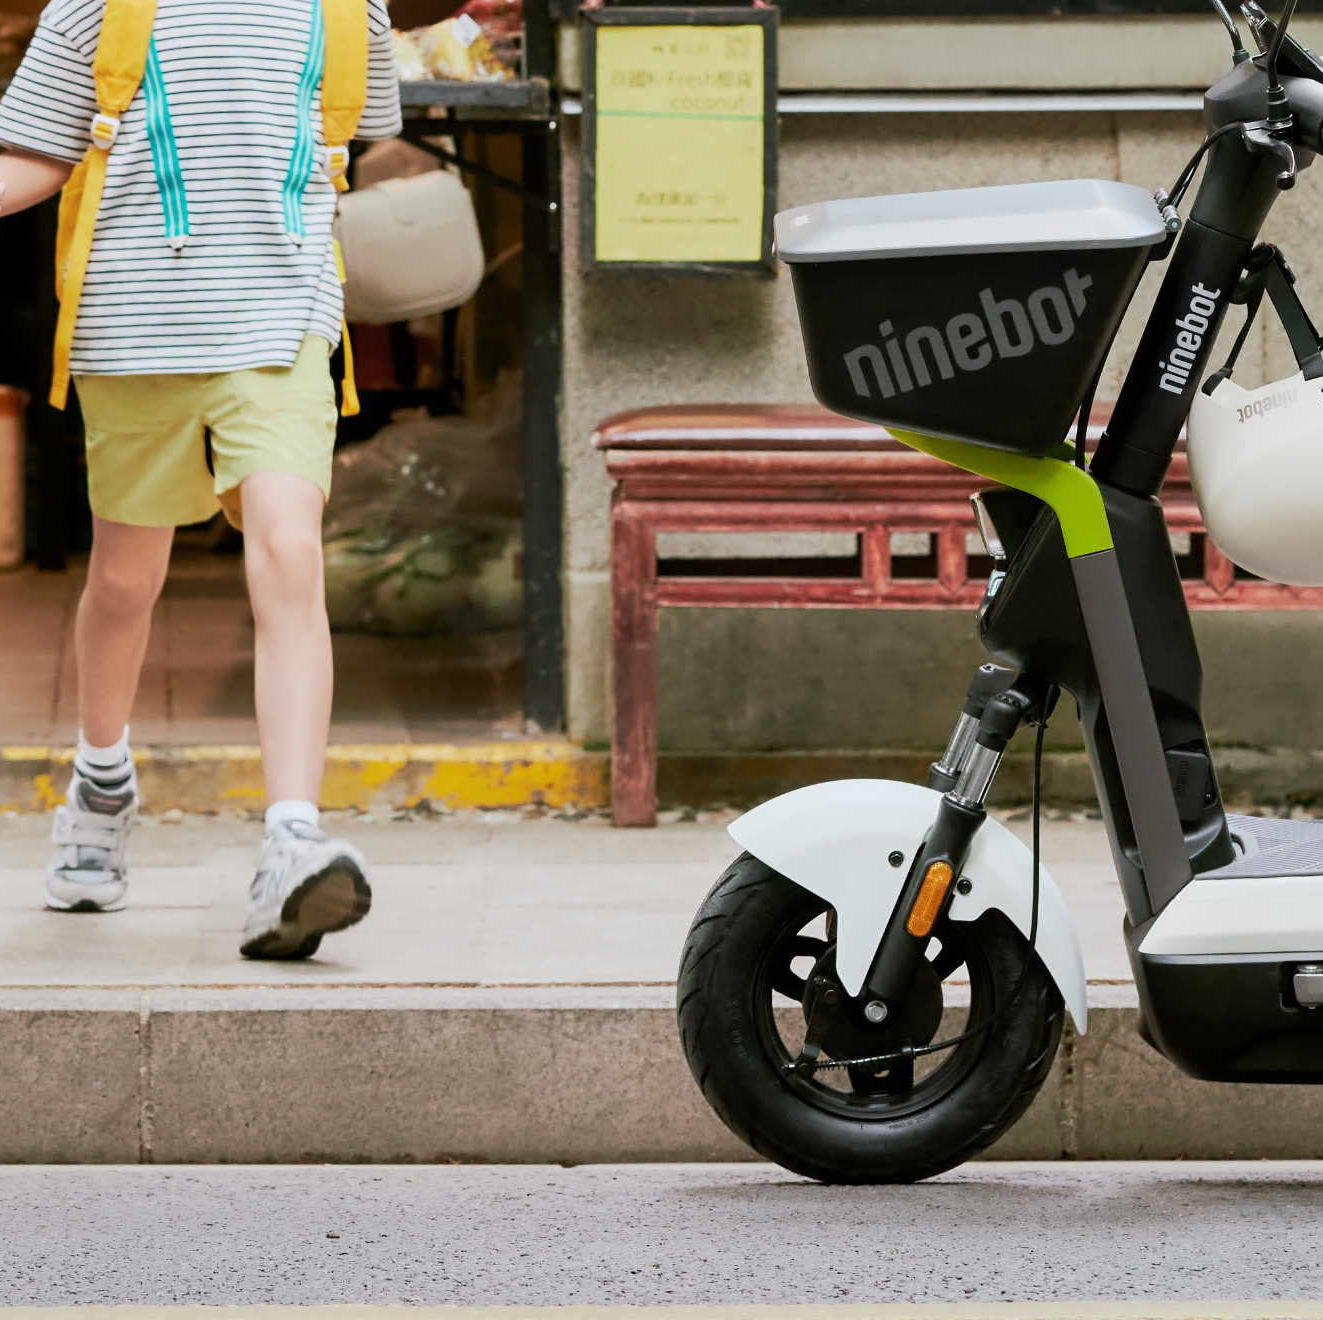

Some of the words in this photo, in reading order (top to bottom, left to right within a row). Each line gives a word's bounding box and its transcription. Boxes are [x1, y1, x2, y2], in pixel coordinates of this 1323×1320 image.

[843, 268, 1094, 401] ninebot
[1158, 281, 1223, 395] ninebot
[1237, 388, 1298, 424] ninebot
